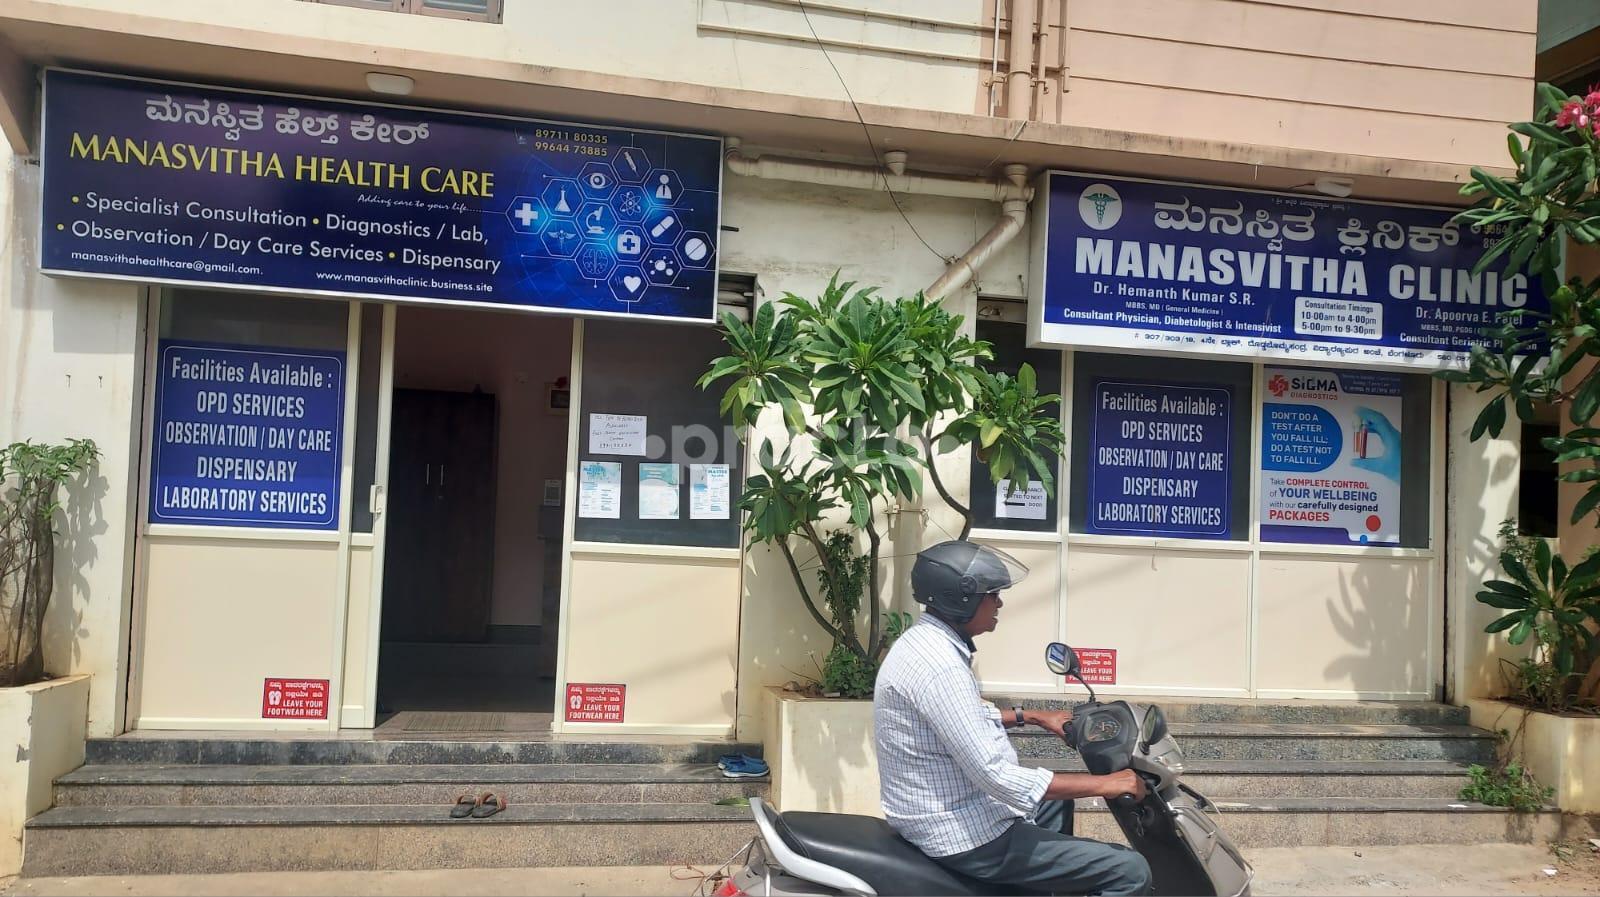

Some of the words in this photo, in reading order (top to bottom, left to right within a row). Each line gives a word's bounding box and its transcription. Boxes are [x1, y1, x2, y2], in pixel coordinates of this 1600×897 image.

[146, 94, 264, 142] ಮನಸ್ವಿತ
[275, 107, 339, 145] ಹೆಲ್ತ್
[350, 114, 430, 145] ಕೇರ್
[536, 129, 569, 140] 89711
[574, 132, 608, 144] 80335
[535, 142, 570, 152] 99644
[574, 146, 608, 156] 73885
[70, 132, 286, 179] MANASVITHA
[294, 155, 410, 190] HEALTH
[420, 166, 494, 198] CARE
[357, 194, 392, 208] Adding
[414, 200, 424, 208] to
[427, 203, 450, 212] your
[86, 192, 179, 217] Specialist
[186, 202, 307, 228] Consultation
[326, 213, 430, 239] Diagnostics
[452, 224, 489, 246] Lab,
[1154, 195, 1316, 252] ಮನಸ್ವಿತ
[1337, 217, 1460, 256] ಕ್ಲಿನಿಕ್
[72, 220, 193, 247] Observation
[214, 233, 250, 254] Day
[258, 237, 303, 256] Care
[310, 241, 384, 262] Services
[403, 248, 501, 274] Dispensary
[316, 271, 493, 292] www.manasvithaclinic.business.site
[1075, 237, 1368, 296] MANASVITHA
[1388, 264, 1528, 308] CLINIC
[1094, 282, 1113, 295] Dr.
[1118, 284, 1177, 300] Hemanth
[1182, 288, 1224, 304] Kumar
[1229, 292, 1256, 306] S.R.
[1304, 300, 1346, 310] Consultation
[1348, 304, 1374, 314] Timings
[1416, 306, 1432, 319] Dr.
[1434, 308, 1479, 322] Apoorva
[1482, 311, 1492, 323] E.
[1064, 308, 1113, 322] Consultant
[1116, 310, 1162, 326] Physician,
[1164, 314, 1223, 330] Diabetologist
[1226, 320, 1232, 328] &
[1235, 320, 1282, 334] Intensivist
[1400, 332, 1450, 345] Consultant
[1452, 336, 1492, 348] Geriatric
[172, 357, 245, 382] Facilities
[250, 362, 322, 388] Available
[197, 390, 227, 414] OPD
[232, 393, 305, 418] SERVICES
[1102, 392, 1157, 413] Facilities
[1160, 395, 1216, 416] Available
[1290, 392, 1338, 400] DIAGNOSTICS
[1272, 412, 1297, 420] DON'T
[166, 421, 258, 448] OBSERVATION
[268, 428, 294, 450] DAY
[298, 430, 332, 452] CARE
[1122, 420, 1145, 440] OPD
[1148, 422, 1203, 442] SERVICES
[1272, 422, 1292, 431] TEST
[1294, 424, 1322, 432] AFTER
[1272, 434, 1289, 442] YOU
[1290, 434, 1312, 443] FALL
[1272, 444, 1284, 452] DO
[1284, 444, 1291, 452] A
[1292, 446, 1314, 454] TEST
[1315, 446, 1332, 454] NOT
[196, 456, 298, 482] DISPENSARY
[1099, 446, 1168, 468] OBSERVATION
[1176, 451, 1196, 470] DAY
[1198, 452, 1224, 472] CARE
[1272, 454, 1282, 462] TO
[1284, 456, 1304, 464] FALL
[1306, 456, 1321, 464] ILL.
[1122, 476, 1198, 498] DISPENSARY
[1270, 478, 1285, 486] Take
[1286, 478, 1330, 488] COMPLETE
[1332, 480, 1370, 489] CONTROL
[164, 486, 256, 512] LABORATORY
[260, 490, 327, 514] SERVICES
[1270, 490, 1278, 498] of
[1279, 488, 1310, 498] YOUR
[1313, 489, 1378, 502] WELLBEING
[1098, 502, 1168, 524] LABORATORY
[1171, 506, 1221, 526] SERVICES
[1270, 500, 1284, 509] with
[1297, 501, 1337, 512] carefully
[1338, 502, 1378, 513] designed
[1270, 509, 1330, 522] PACKAGES
[268, 708, 304, 716] FOOTWEAR
[306, 708, 322, 716] HERE
[282, 700, 304, 708] LEAVE
[305, 700, 323, 708] YOUR
